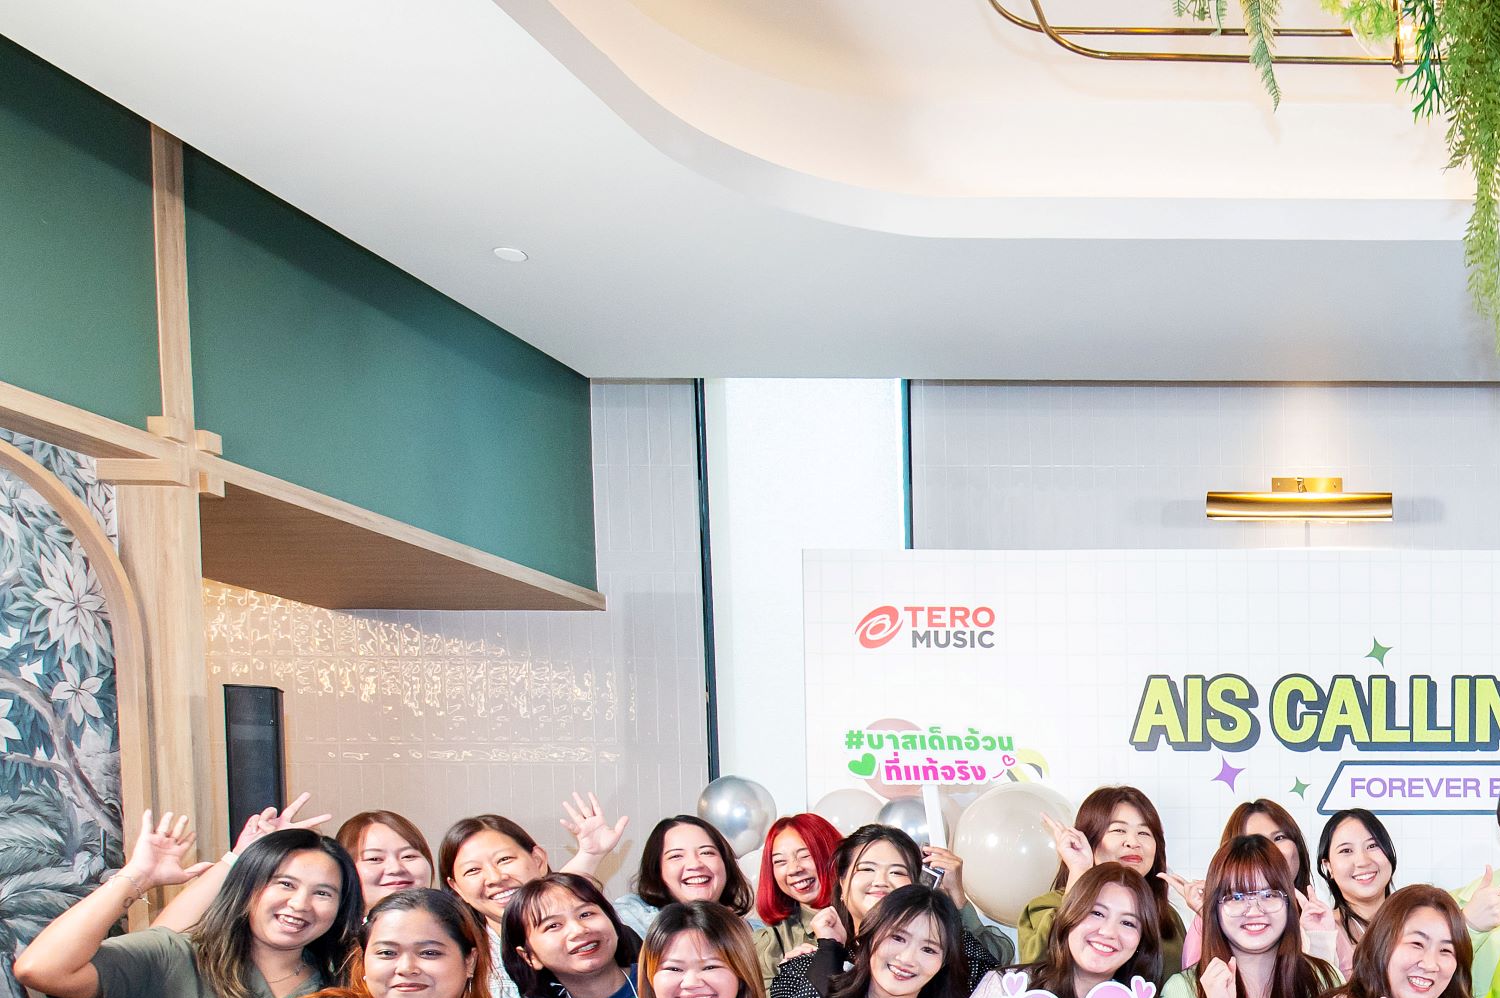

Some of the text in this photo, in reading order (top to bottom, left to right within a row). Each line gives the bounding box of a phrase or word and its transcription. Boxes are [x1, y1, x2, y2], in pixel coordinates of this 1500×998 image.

[904, 607, 995, 628] TERO
[912, 630, 995, 648] MUSIC
[1129, 673, 1261, 752] AIS
[885, 752, 986, 780] ที่แท้จริง
[1350, 777, 1481, 798] FOREVER
